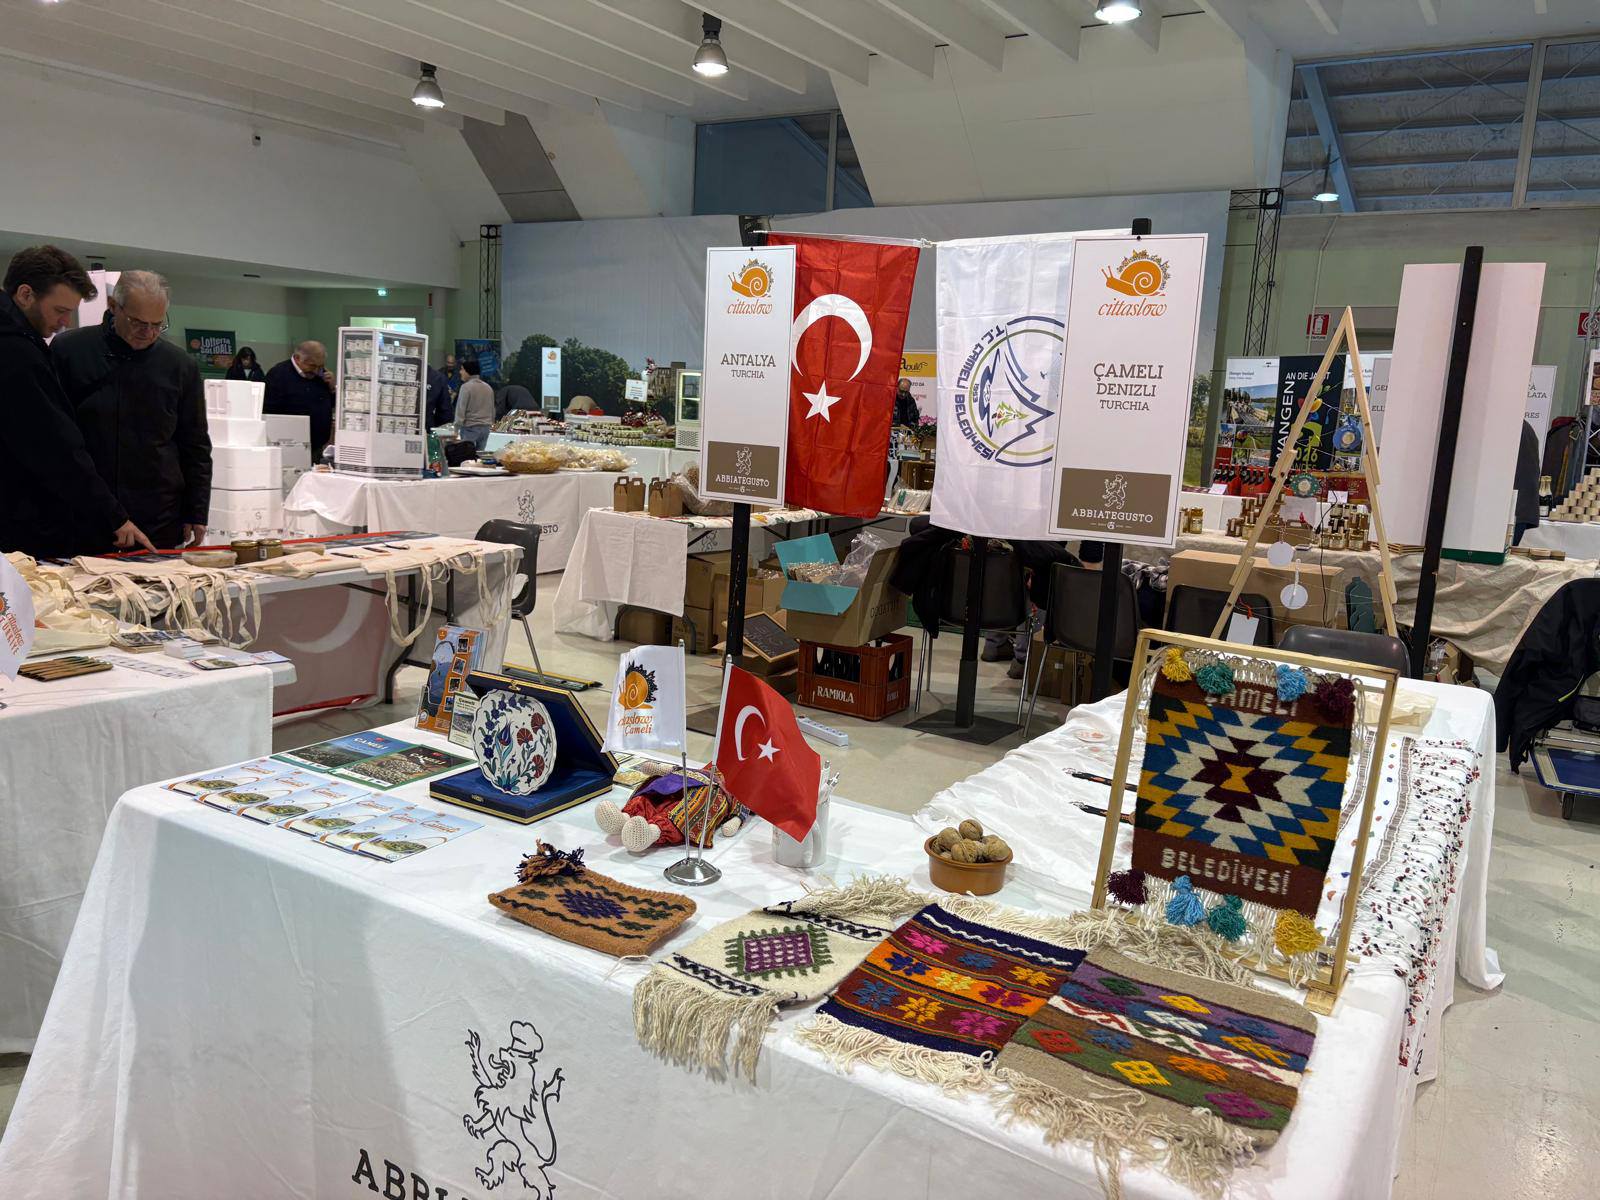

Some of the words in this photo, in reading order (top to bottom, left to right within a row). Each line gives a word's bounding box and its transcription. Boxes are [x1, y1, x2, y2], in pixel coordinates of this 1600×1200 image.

[727, 299, 773, 315] cittaslow
[1098, 298, 1167, 317] cittaslow
[720, 353, 776, 368] ANTALYA
[731, 369, 765, 379] TURCHIA
[1093, 363, 1164, 382] ÇAMELI
[1285, 372, 1297, 381] AN
[1297, 372, 1309, 381] DIE
[1096, 382, 1157, 397] DENIZLI
[1100, 400, 1150, 411] TURCHIA
[1295, 447, 1318, 462] 026
[715, 474, 770, 487] ABBIATEGUSTO
[1071, 507, 1153, 523] ABBIATEGUSTO
[624, 724, 653, 736] Çameli
[1160, 848, 1292, 896] BELEDİYESİ
